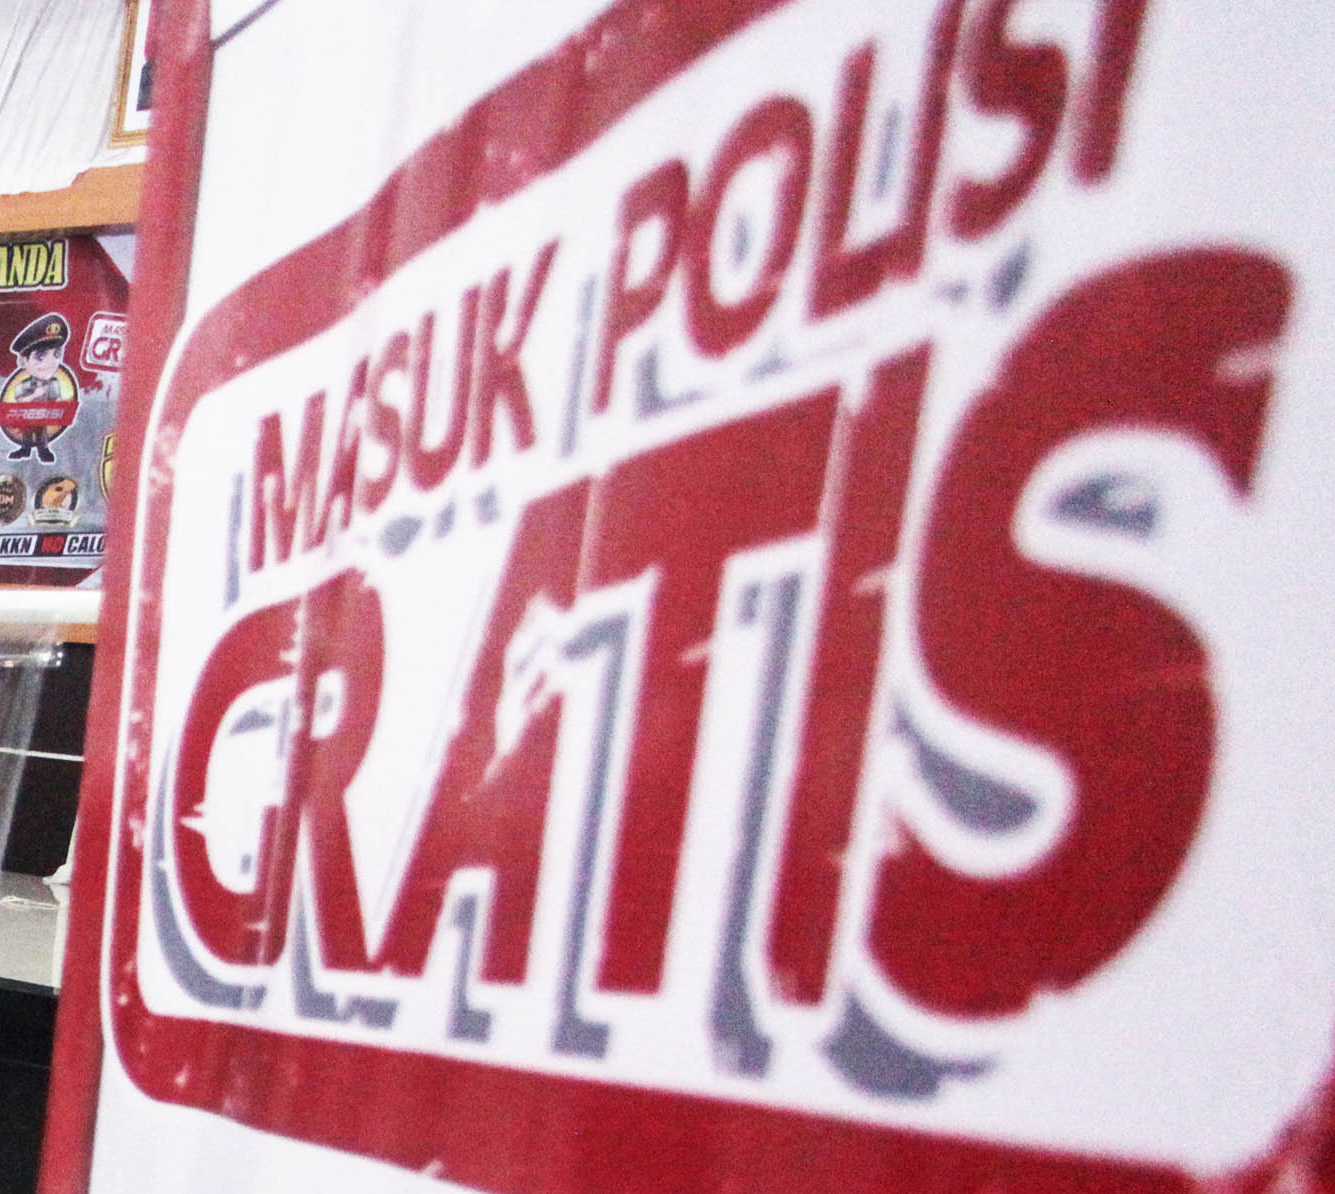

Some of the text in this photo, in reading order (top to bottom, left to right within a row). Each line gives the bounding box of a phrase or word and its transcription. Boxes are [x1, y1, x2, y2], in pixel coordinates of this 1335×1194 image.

[0, 537, 32, 554] KKN
[247, 0, 1146, 574] MASUK POLISI
[174, 245, 1295, 1019] GRATIS
